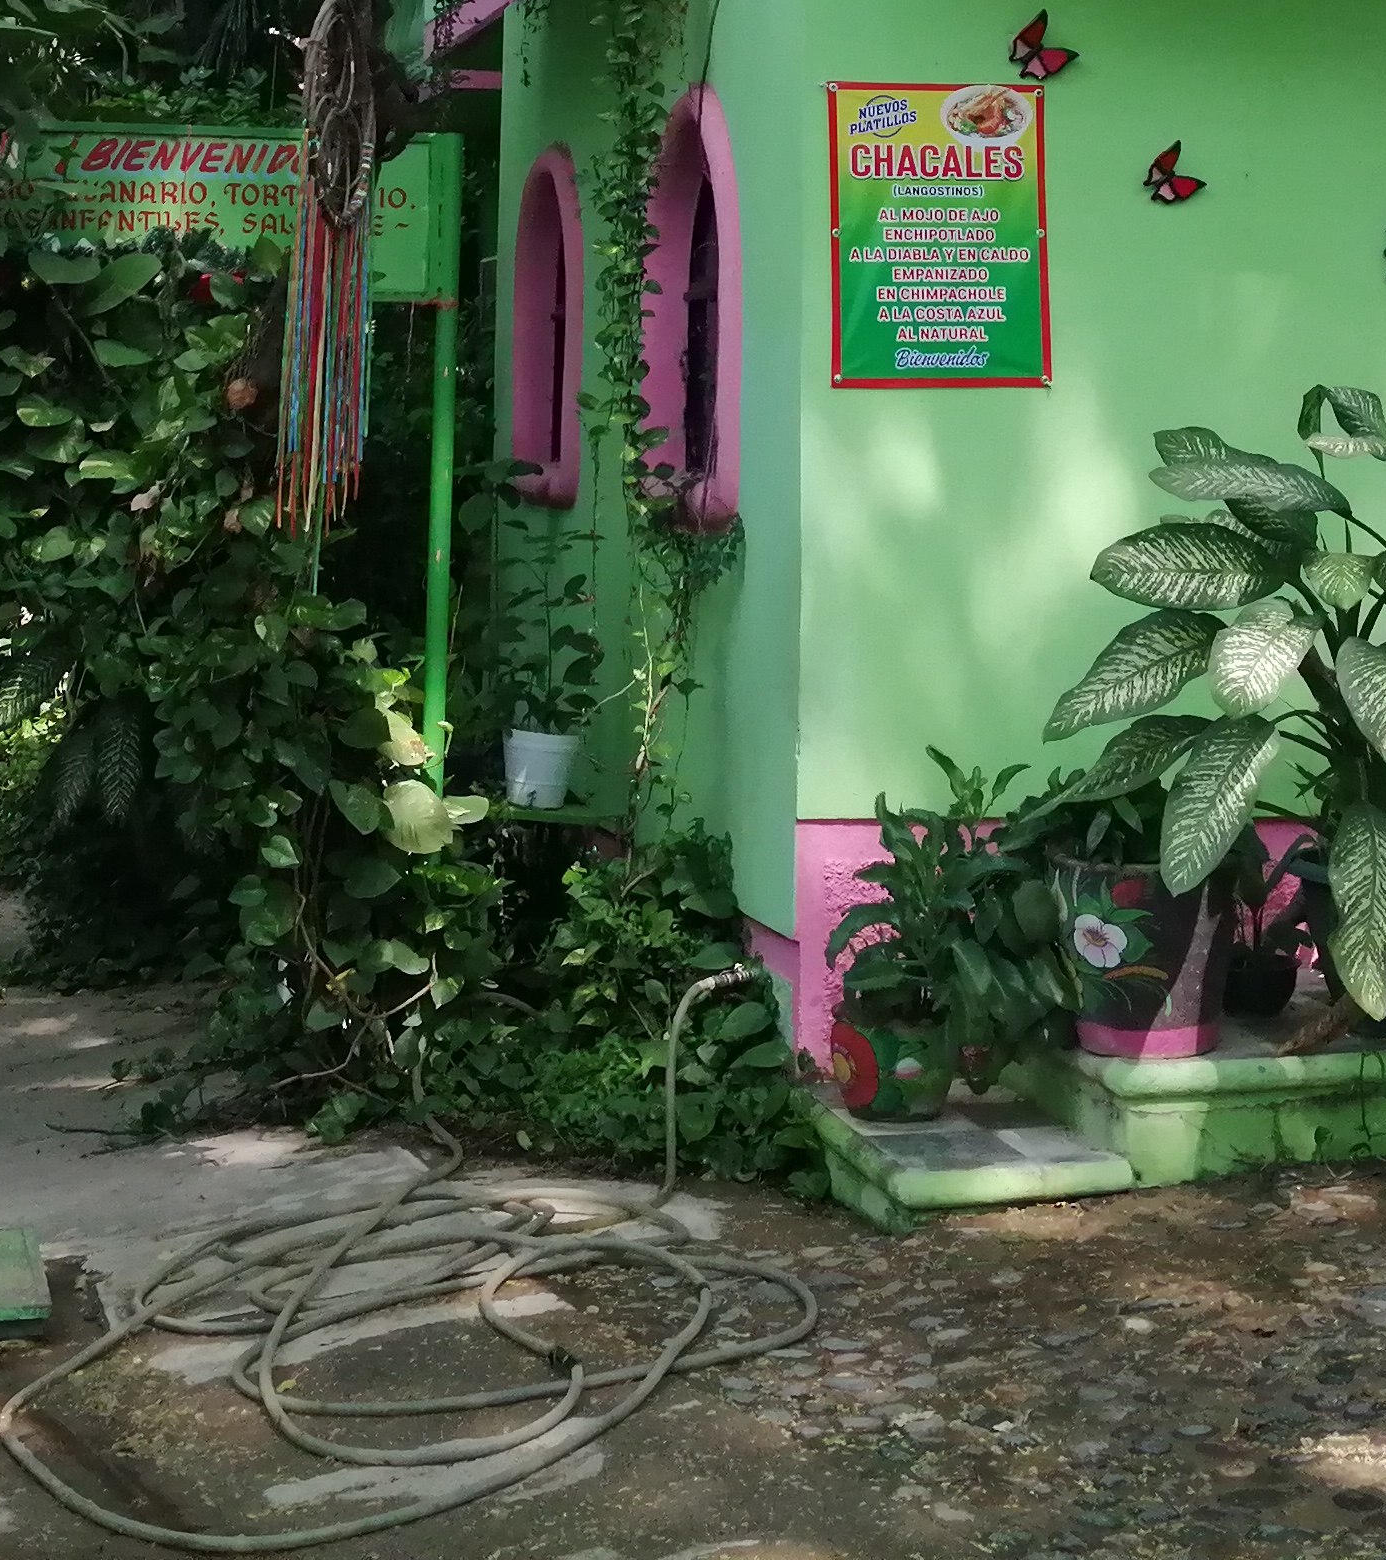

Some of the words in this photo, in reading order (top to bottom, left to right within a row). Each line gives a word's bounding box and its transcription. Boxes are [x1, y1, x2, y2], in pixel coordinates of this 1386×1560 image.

[858, 98, 908, 120] NUEVOS
[849, 110, 918, 136] PLATILLOS
[851, 144, 1024, 178] CHACALES
[892, 185, 984, 198] (LANGOSTINOS)
[879, 208, 898, 222] AL
[902, 208, 944, 222] MOJO
[948, 209, 966, 222] DE
[971, 209, 1000, 223] AJO
[884, 228, 996, 242] ENCHIPOTLADO
[850, 248, 861, 262] A
[865, 248, 884, 261] LA
[888, 248, 940, 261] DIABLA
[944, 248, 954, 261] Y
[959, 249, 976, 261] EN
[981, 249, 1030, 262] CALDO
[893, 268, 989, 281] EMPANIZADO
[877, 288, 897, 300] EN
[900, 288, 1005, 301] CHIMPACHOLE
[879, 307, 889, 320] A
[894, 308, 911, 320] LA
[915, 308, 963, 320] COSTA
[967, 308, 1005, 320] AZUL
[897, 327, 916, 341] AL
[920, 327, 988, 341] NATURAL
[895, 345, 989, 369] Bienvenidos
